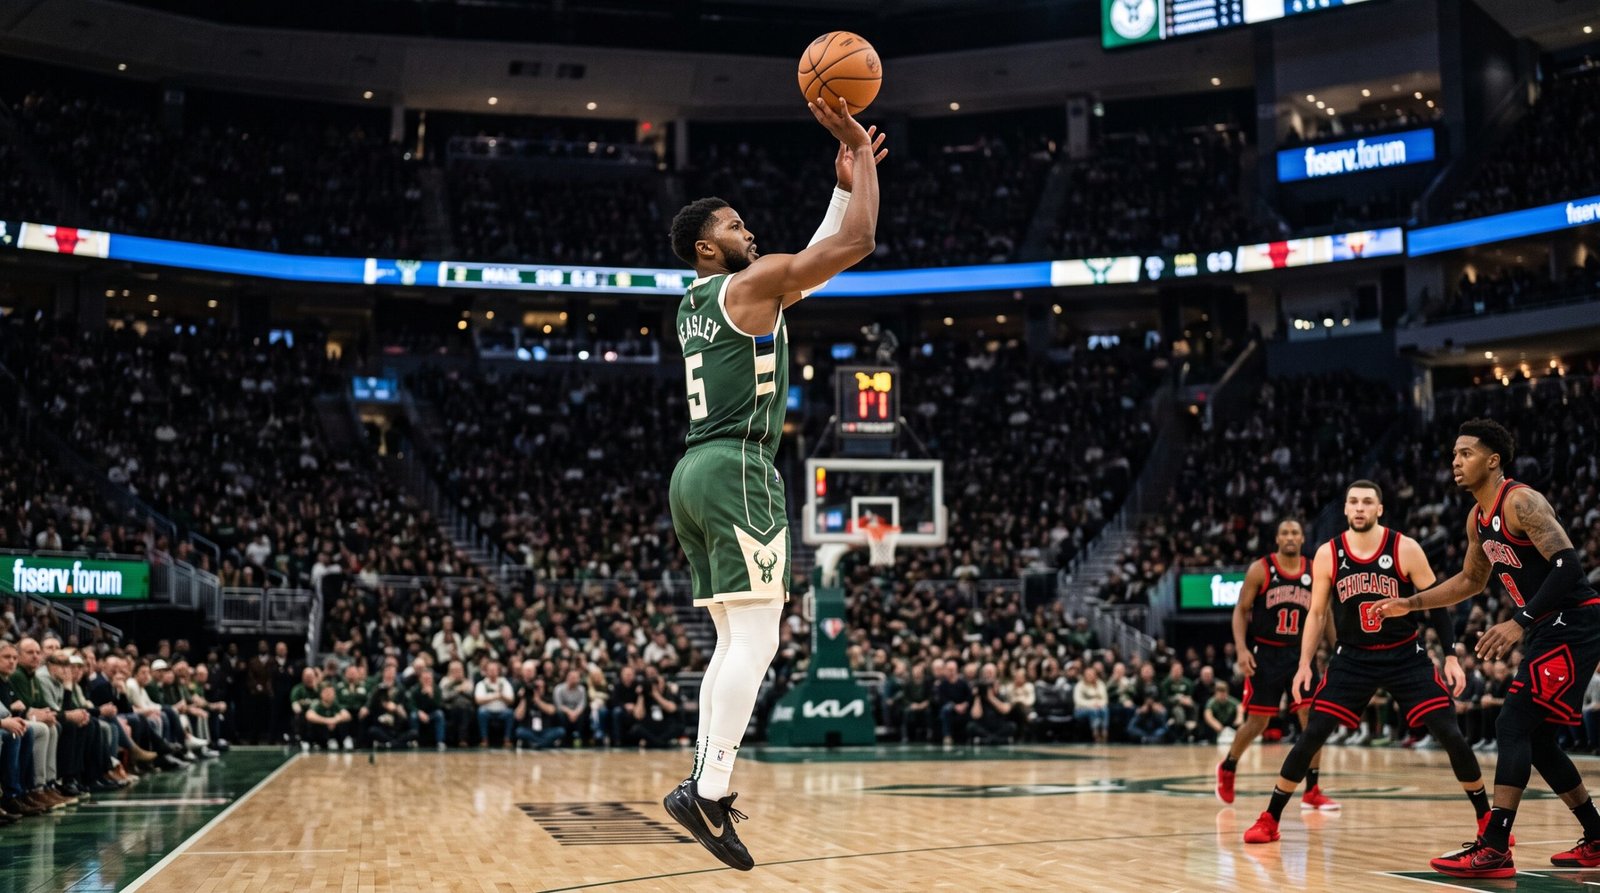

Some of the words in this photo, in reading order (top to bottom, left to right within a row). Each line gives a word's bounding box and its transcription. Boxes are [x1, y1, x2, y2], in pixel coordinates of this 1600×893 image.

[678, 314, 722, 353] EASLEY
[685, 352, 708, 420] 5
[13, 558, 122, 595] fiserv.forum
[1336, 572, 1399, 604] CHICAGO
[1266, 585, 1311, 609] CHICAG
[1276, 608, 1300, 635] 11
[802, 698, 865, 718] KIA
